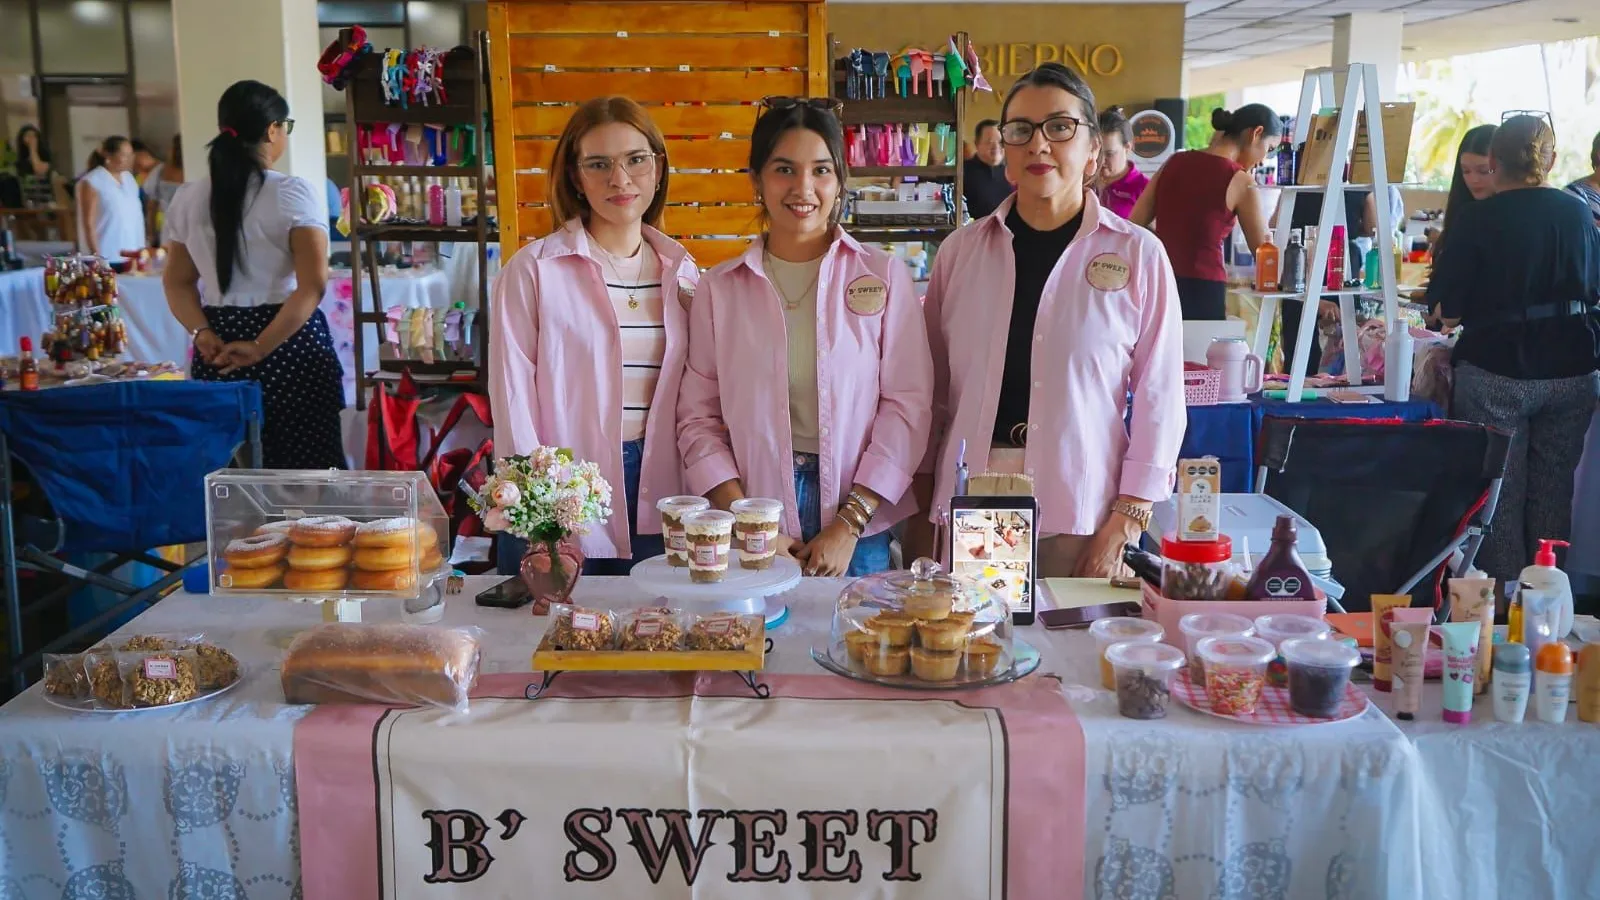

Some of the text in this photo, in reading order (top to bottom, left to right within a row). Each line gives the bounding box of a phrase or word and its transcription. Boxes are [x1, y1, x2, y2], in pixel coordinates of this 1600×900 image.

[902, 43, 1123, 77] BIERNO
[1101, 262, 1127, 273] SWEET
[563, 807, 938, 885] SWEET
